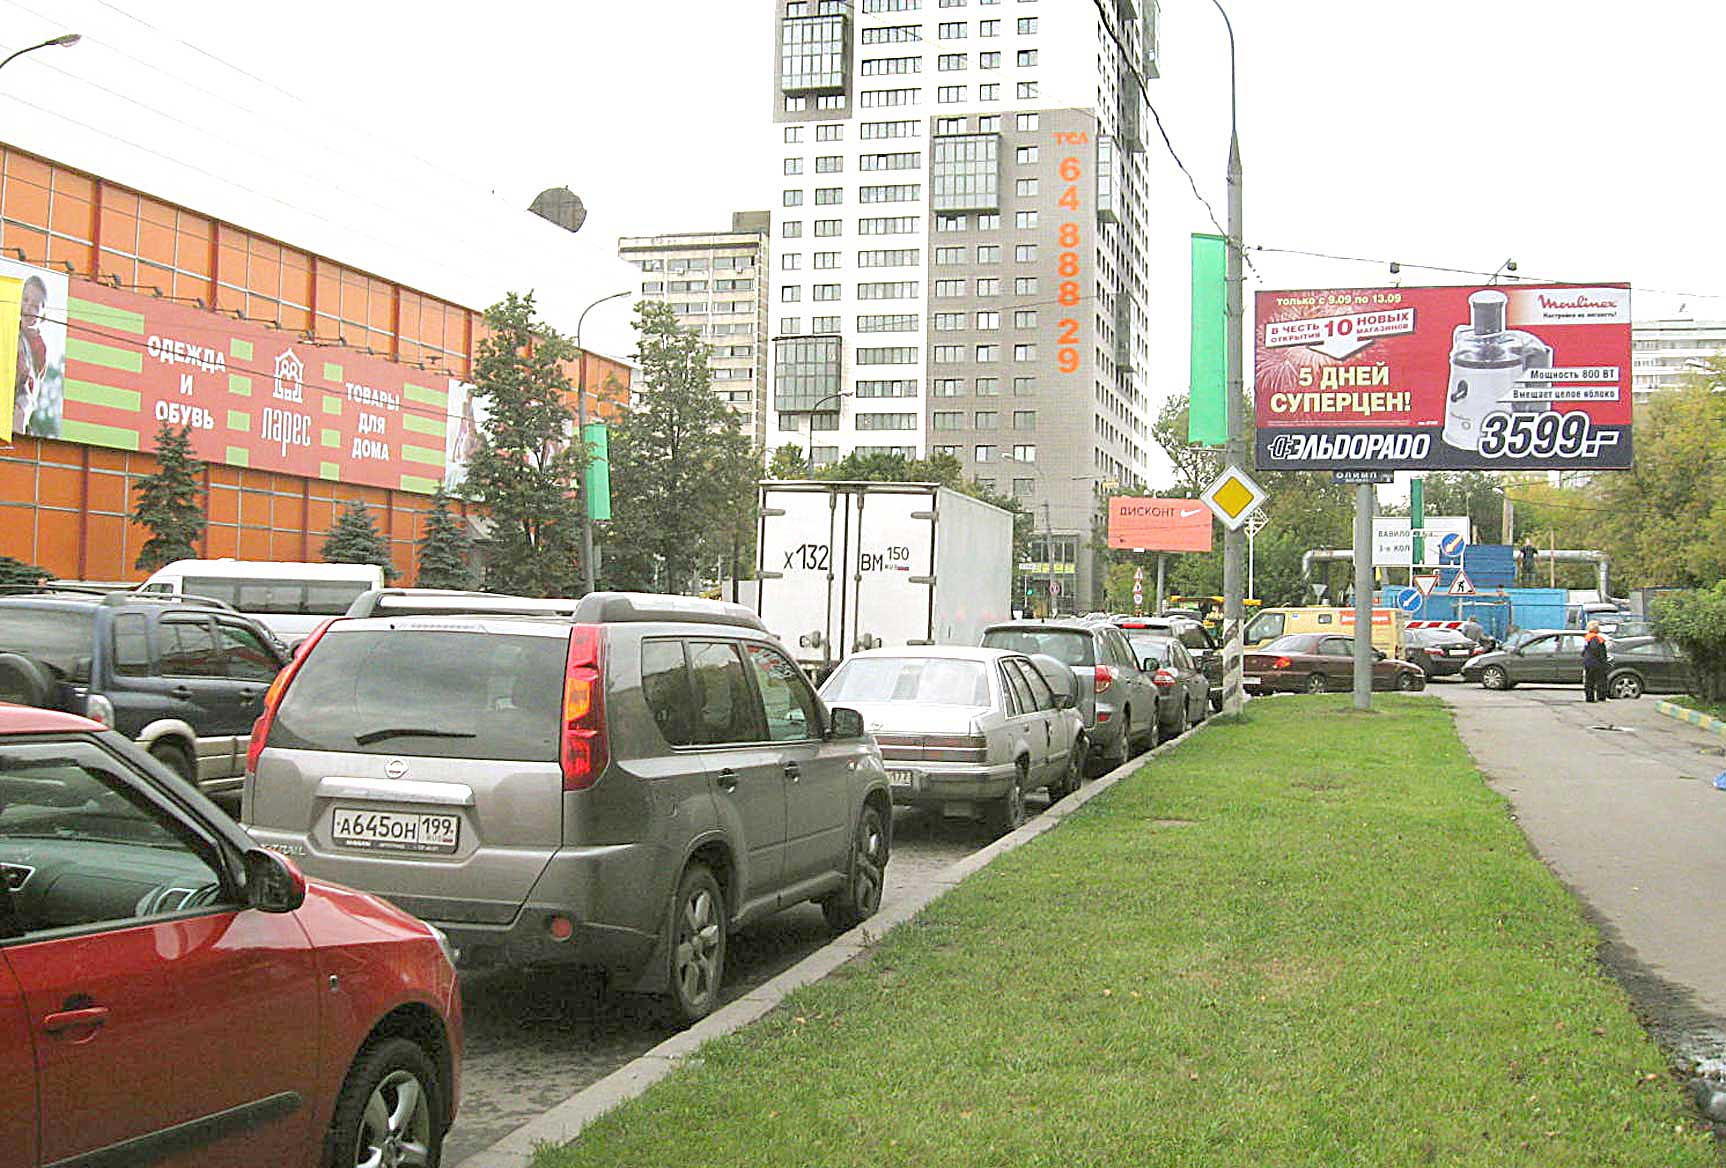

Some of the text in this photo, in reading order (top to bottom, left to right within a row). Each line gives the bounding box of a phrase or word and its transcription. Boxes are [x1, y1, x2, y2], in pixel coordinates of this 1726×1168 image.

[1328, 295, 1352, 305] 9.09
[1354, 295, 1369, 305] по
[1372, 293, 1402, 304] 13.09
[1537, 294, 1617, 309] Moulinex
[1270, 323, 1320, 335] В ЧЕСТЬ
[1323, 318, 1353, 337] 10
[1357, 312, 1409, 326] НОВЫХ
[1270, 332, 1320, 343] ОТКРЫТИЯ
[147, 335, 226, 374] ОДЕЖДА
[180, 373, 194, 396] И
[1299, 361, 1390, 390] 5 ДНЕЙ
[1530, 369, 1579, 380] Мощность
[1582, 369, 1600, 379] 800
[346, 382, 401, 412] ТОВАРЫ
[1270, 391, 1412, 417] СУПЕРЦЕН!
[1512, 388, 1615, 400] Вмещает целое яблоко
[155, 400, 215, 430] ОБУВЬ
[358, 412, 386, 435] ДЛЯ
[351, 437, 390, 462] ДОМА
[1120, 506, 1175, 518] ДИСКОНТ
[860, 553, 884, 572] ВМ
[886, 546, 910, 562] 150
[340, 814, 452, 840] А645ОН 199
